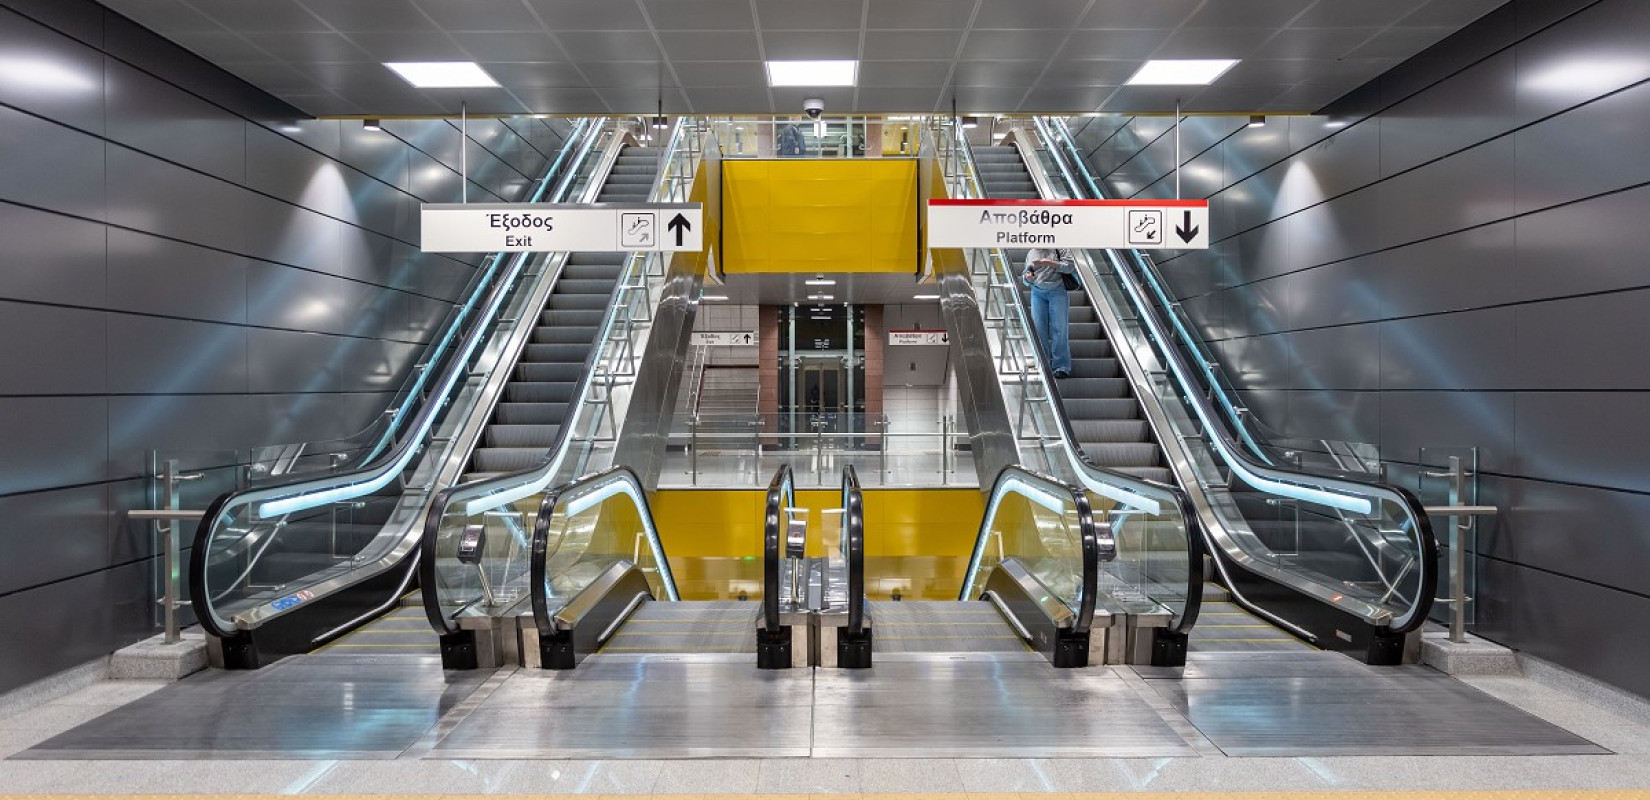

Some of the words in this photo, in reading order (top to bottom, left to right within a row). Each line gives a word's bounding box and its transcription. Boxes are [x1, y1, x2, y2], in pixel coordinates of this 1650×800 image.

[486, 213, 553, 231] Έξοδος
[979, 210, 1073, 227] Αποβάθρα
[505, 235, 532, 247] Exit
[996, 231, 1056, 244] Platform
